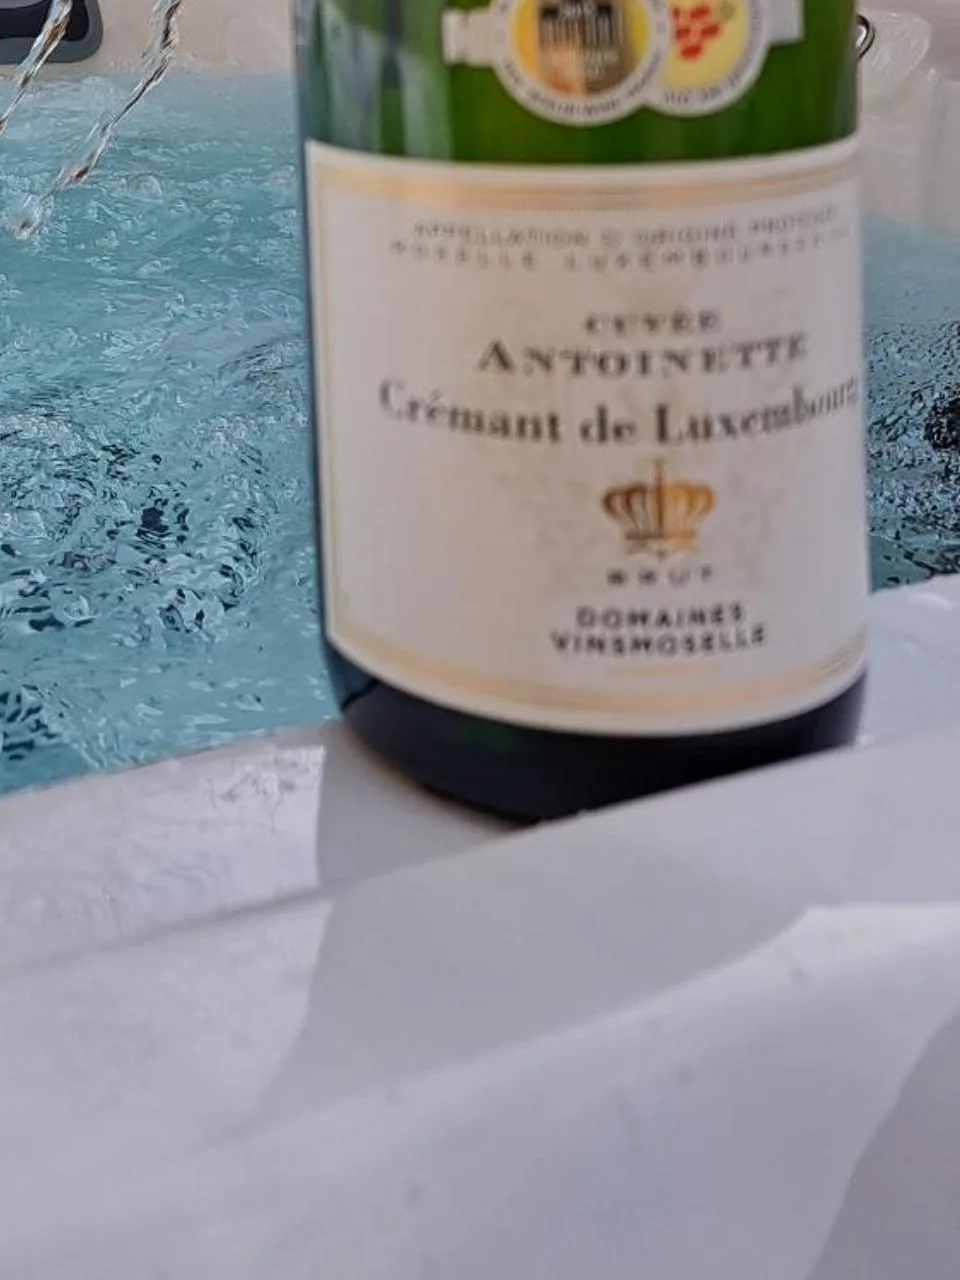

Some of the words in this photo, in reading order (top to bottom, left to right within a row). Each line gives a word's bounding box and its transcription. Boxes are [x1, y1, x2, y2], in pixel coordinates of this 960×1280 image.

[584, 306, 718, 335] CUVÉE
[478, 332, 807, 378] ANTOINETTE
[380, 379, 558, 445] Crémant
[580, 403, 636, 445] de
[656, 376, 859, 446] Luxembourg
[607, 564, 711, 588] BRUT
[576, 602, 742, 629] DOMAINES
[549, 621, 766, 656] VINSMOSELLE
